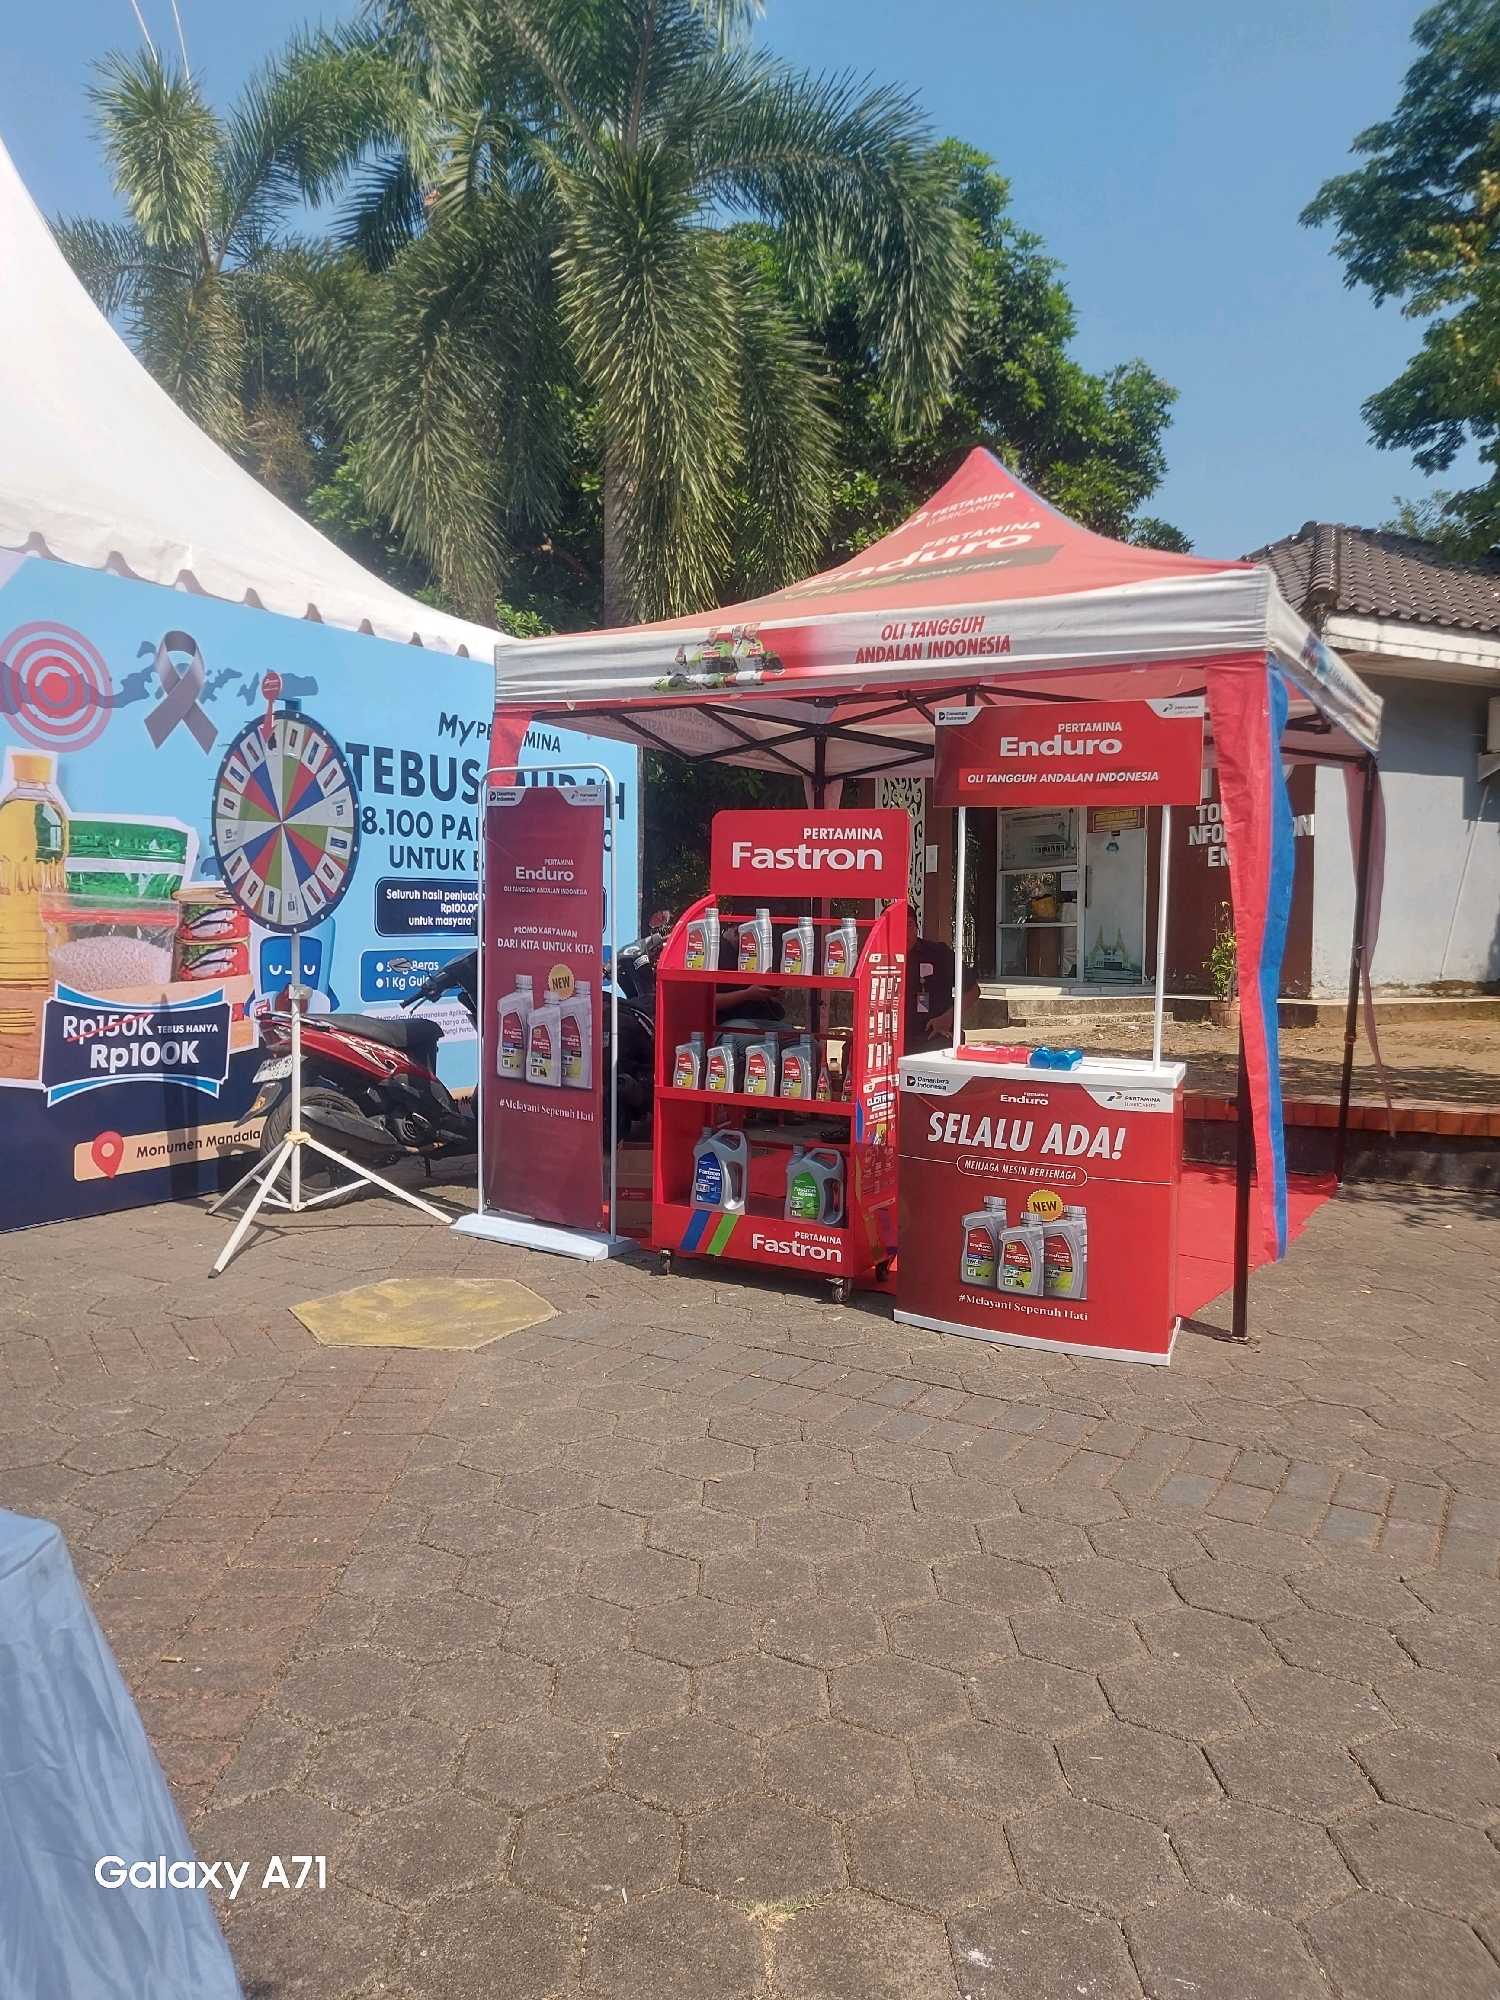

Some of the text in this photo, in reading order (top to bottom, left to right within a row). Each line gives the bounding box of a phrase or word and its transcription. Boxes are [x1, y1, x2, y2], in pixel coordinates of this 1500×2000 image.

[926, 502, 1000, 527] LUBRICANTS
[933, 491, 1015, 517] PERTAMINA
[922, 521, 1041, 549] PERTAMINA
[800, 534, 1032, 589] Enduro
[881, 616, 985, 641] OLI TANGGUH
[855, 636, 1011, 664] ANDALAN INDONESIA
[1058, 721, 1122, 733] PERTAMINA
[1000, 735, 1122, 757] Enduro
[345, 742, 481, 805] TEBUS
[967, 770, 1159, 783] OLI TANGGUH ANDALAN INDONESIA
[361, 806, 433, 839] 8.100
[803, 828, 883, 840] PERTAMINA
[389, 845, 465, 870] UNTUK
[544, 858, 574, 866] PERTAMINA
[732, 842, 883, 870] Fastron
[515, 866, 574, 881] Enduro
[386, 888, 420, 900] Seluruh
[422, 888, 442, 900] hasil
[408, 916, 471, 927] untuk masyara
[513, 926, 578, 938] PROMO KARYAWAN
[497, 938, 595, 954] DARI KITA UNTUK KITA
[412, 960, 439, 971] Beras
[392, 977, 405, 990] Kg
[552, 976, 570, 990] NEW
[63, 1012, 219, 1044] Rp150K TEBUS HANYA
[90, 1041, 200, 1073] Rp100K
[499, 1098, 540, 1113] #Melayani
[541, 1105, 575, 1118] Sepenuh
[1000, 1094, 1049, 1106] Enduro
[1124, 1095, 1161, 1103] PERTAMINA
[136, 1130, 261, 1158] Monumen Mandala
[927, 1111, 1127, 1160] SELALU ADA!
[964, 1159, 1077, 1181] MENJAGA MESIN BERTENAGA
[1032, 1200, 1057, 1213] NEW
[752, 1233, 842, 1262] Fastron
[794, 1230, 842, 1245] PERTAMINA
[958, 1293, 1089, 1321] #Melayani Sepenuh Hati
